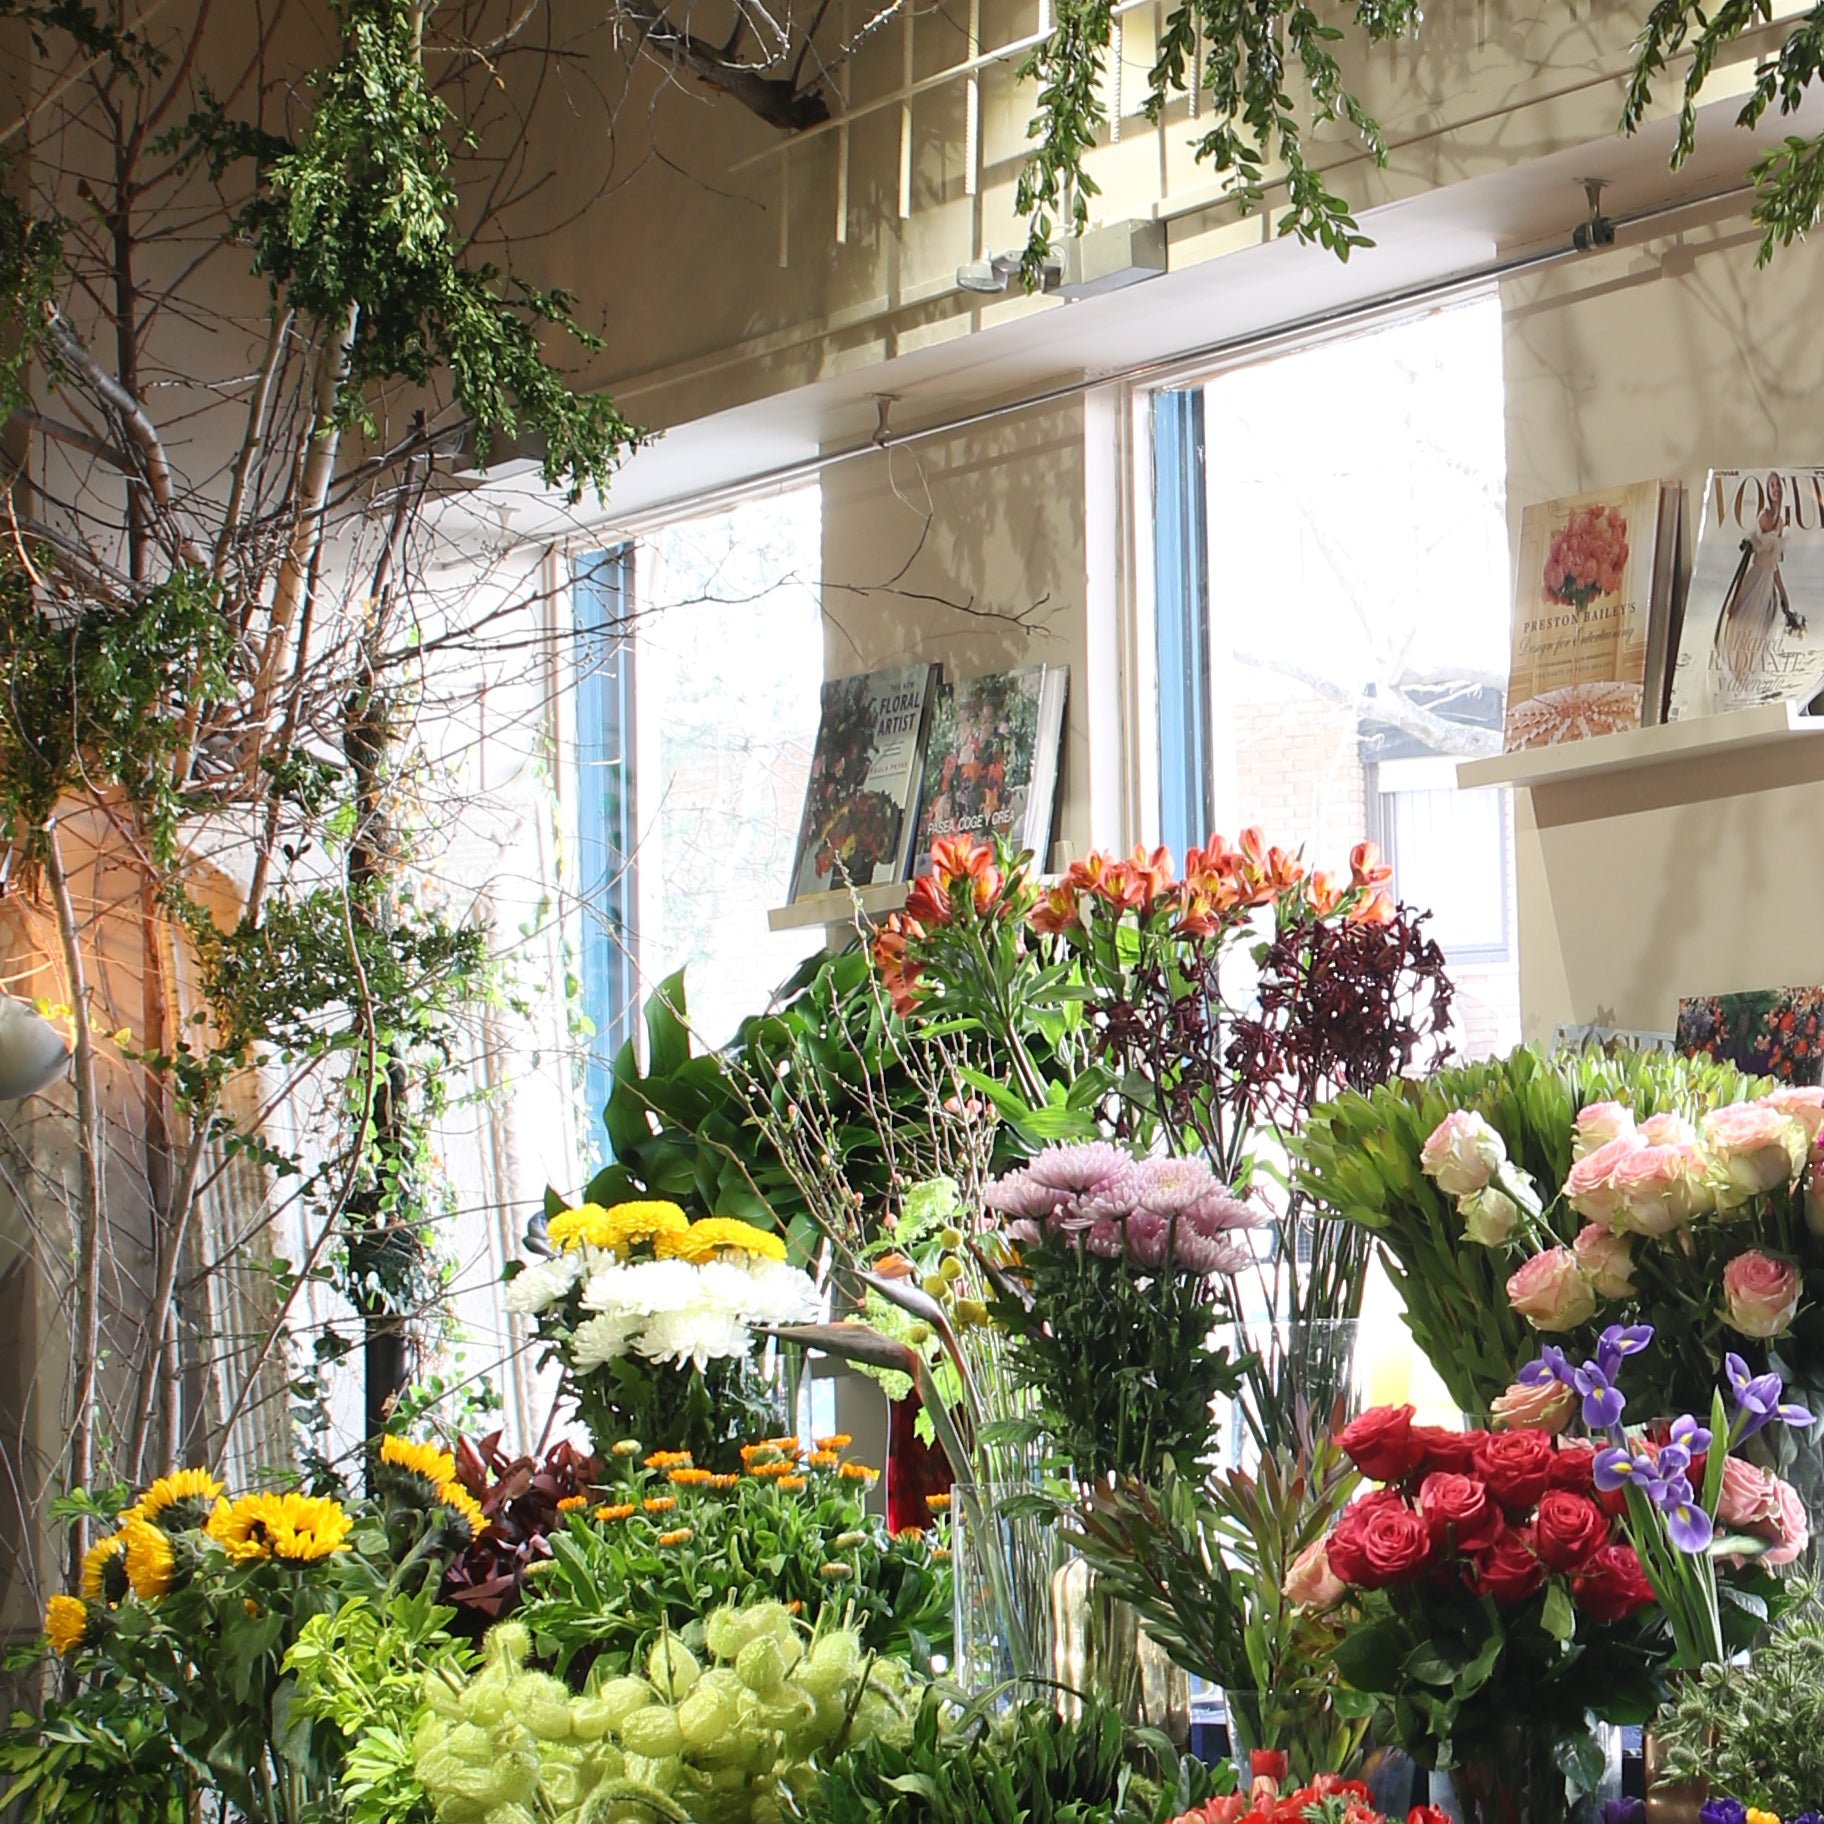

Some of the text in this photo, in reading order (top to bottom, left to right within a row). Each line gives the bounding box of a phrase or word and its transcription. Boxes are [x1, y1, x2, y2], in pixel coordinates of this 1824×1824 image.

[1523, 601, 1637, 634] PRESTON BAILEY'S
[1553, 637, 1572, 656] for
[880, 692, 921, 716] FLORAL
[876, 713, 916, 737] ARTIST
